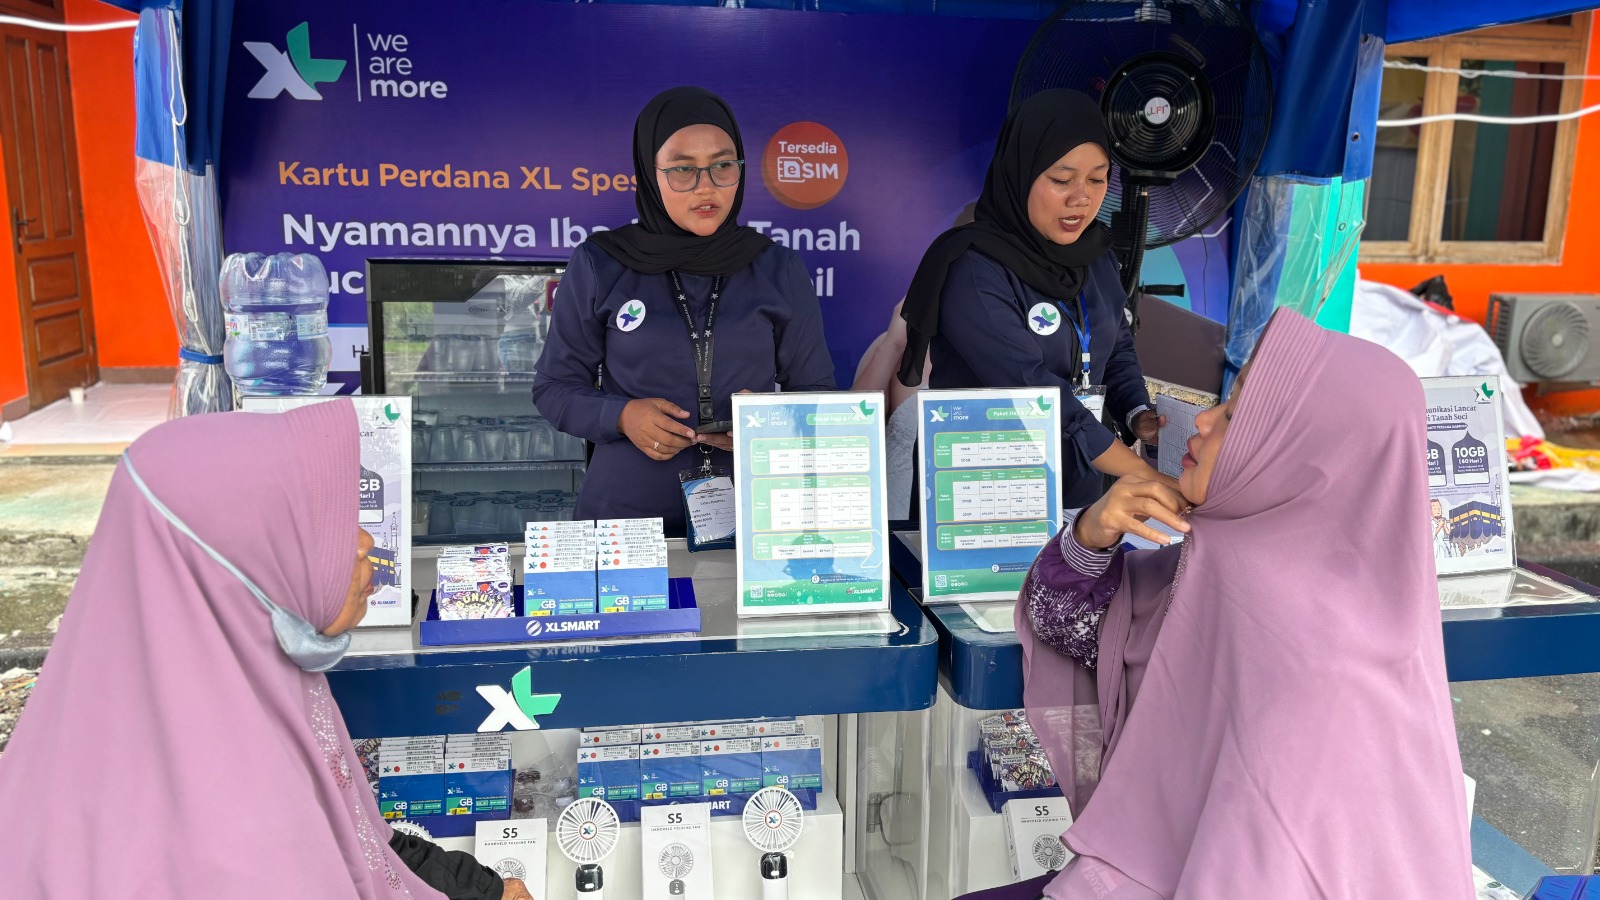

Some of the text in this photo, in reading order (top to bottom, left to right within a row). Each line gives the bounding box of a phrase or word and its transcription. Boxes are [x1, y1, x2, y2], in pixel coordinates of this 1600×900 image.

[367, 33, 409, 52] we
[243, 21, 347, 100] XL
[369, 56, 413, 75] are
[370, 79, 448, 99] more
[778, 141, 838, 154] Tersedia
[278, 161, 370, 187] Kartu
[379, 163, 510, 189] Perdana
[520, 166, 562, 190] XL
[782, 160, 839, 180] eSIM
[283, 213, 536, 254] Nyamannya
[748, 221, 860, 251] Tanah
[1431, 413, 1453, 421] Tanah
[1454, 412, 1468, 420] Suci
[1454, 446, 1486, 459] 10GB
[541, 600, 556, 609] GB
[615, 596, 630, 606] GB
[545, 620, 601, 633] XLSMART
[476, 665, 562, 733] XL
[716, 779, 729, 788] GB
[776, 775, 789, 784] GB
[592, 787, 606, 796] GB
[655, 783, 668, 792] GB
[394, 802, 408, 810] GB
[460, 798, 473, 807] GB
[1034, 805, 1050, 816] S5
[667, 812, 683, 824] S5
[503, 827, 518, 839] S5
